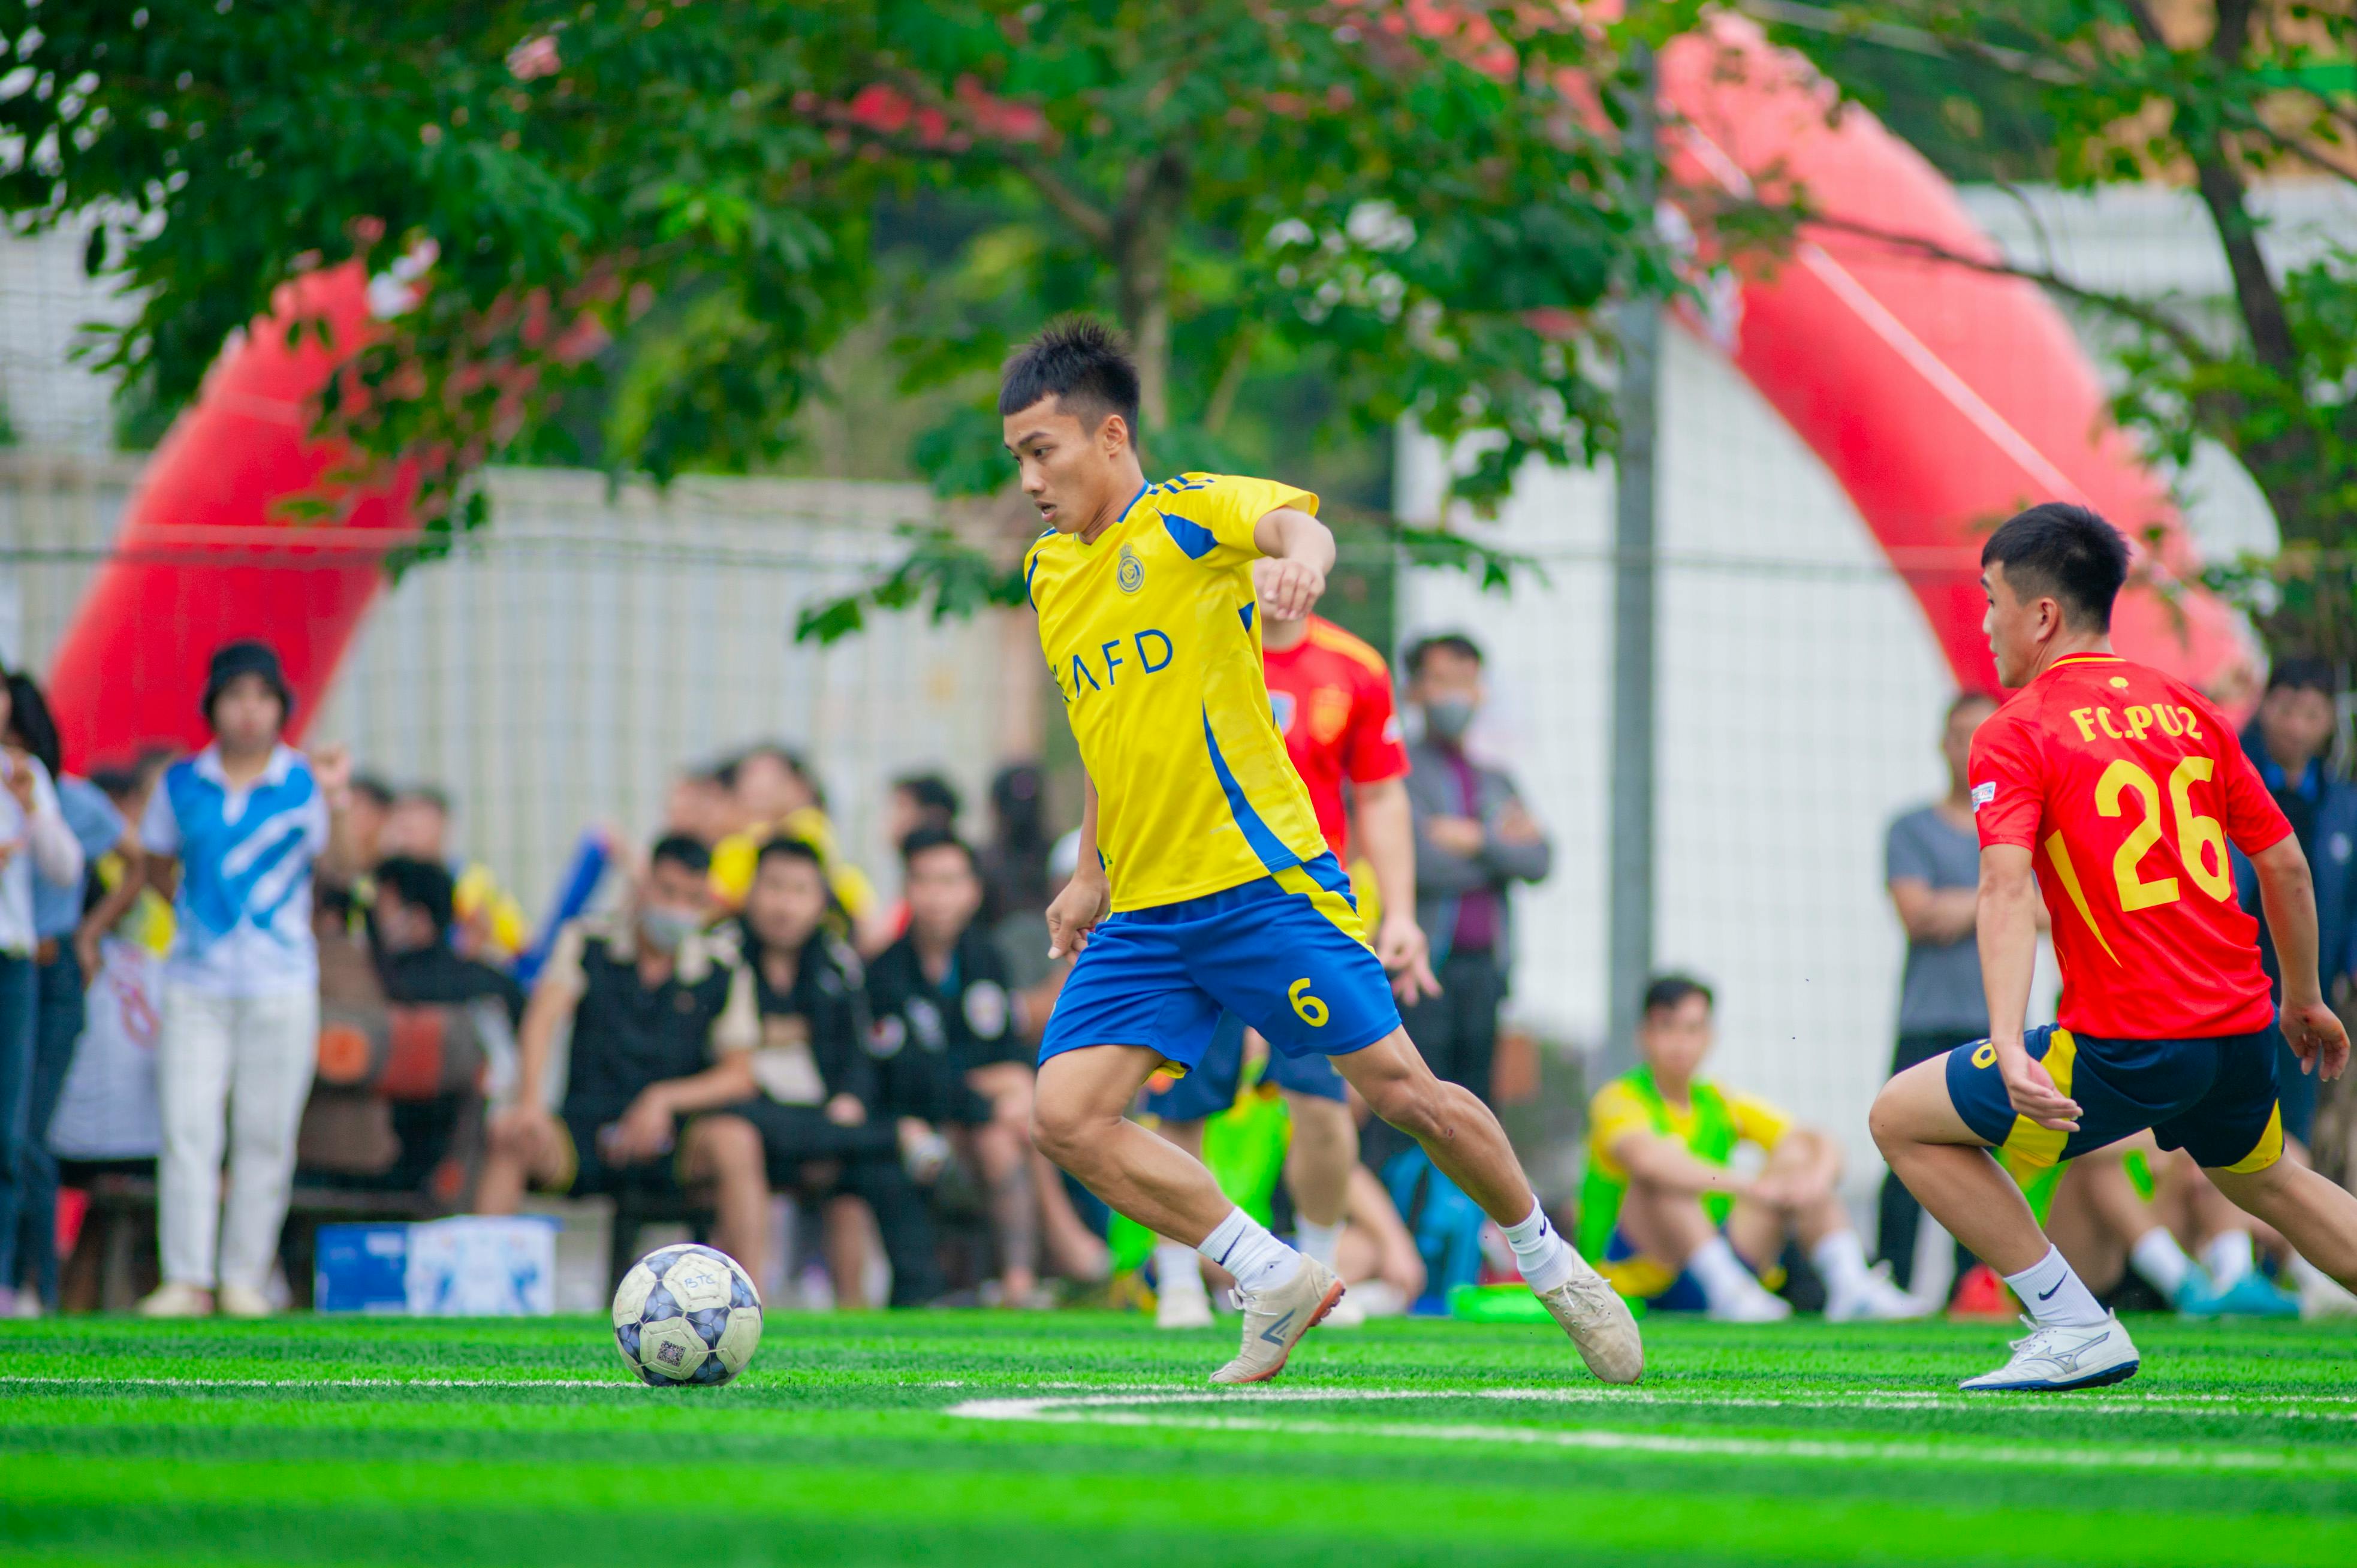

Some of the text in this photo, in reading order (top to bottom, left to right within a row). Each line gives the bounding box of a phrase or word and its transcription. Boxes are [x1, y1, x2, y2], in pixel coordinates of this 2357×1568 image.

[2069, 703, 2203, 742] FC.PU2
[2094, 756, 2231, 912] 26
[1288, 978, 1330, 1027] 6
